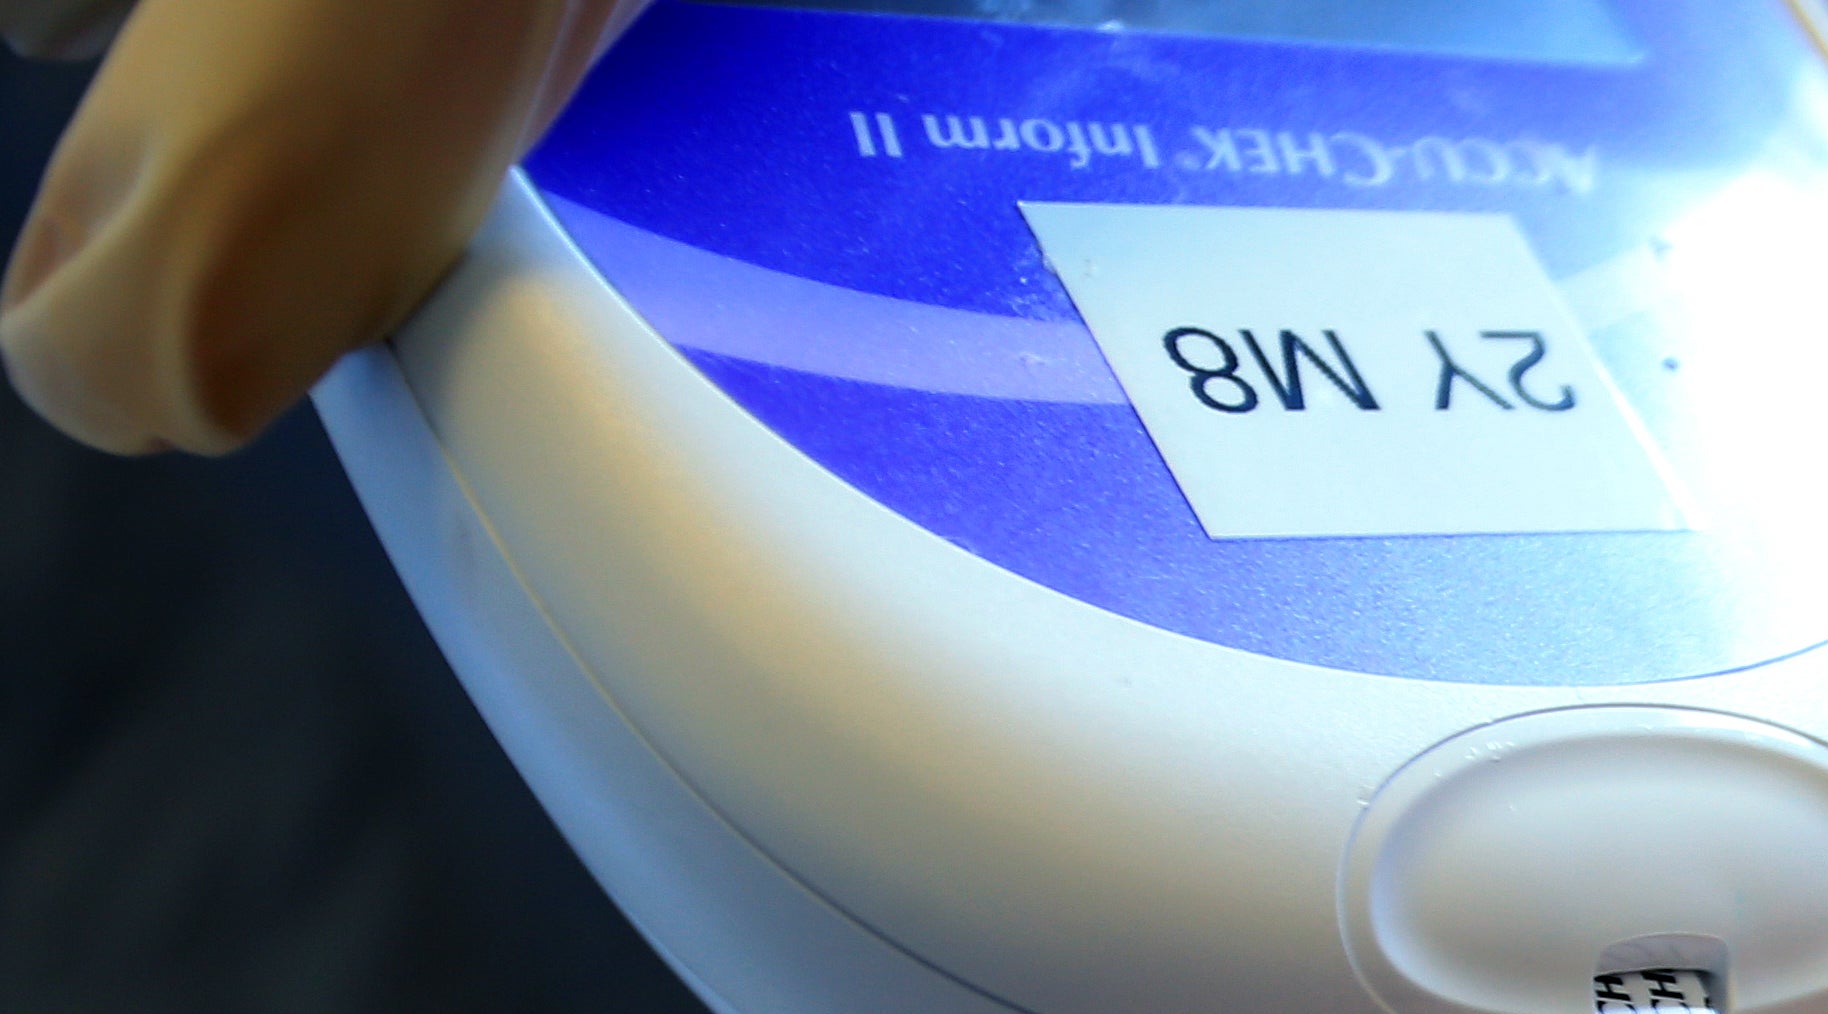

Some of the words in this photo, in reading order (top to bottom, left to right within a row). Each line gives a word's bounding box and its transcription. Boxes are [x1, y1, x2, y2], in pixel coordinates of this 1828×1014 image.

[849, 111, 902, 159] II
[922, 112, 1160, 170] Inform
[1163, 325, 1382, 416] M8
[1424, 327, 1579, 414] 2Y
